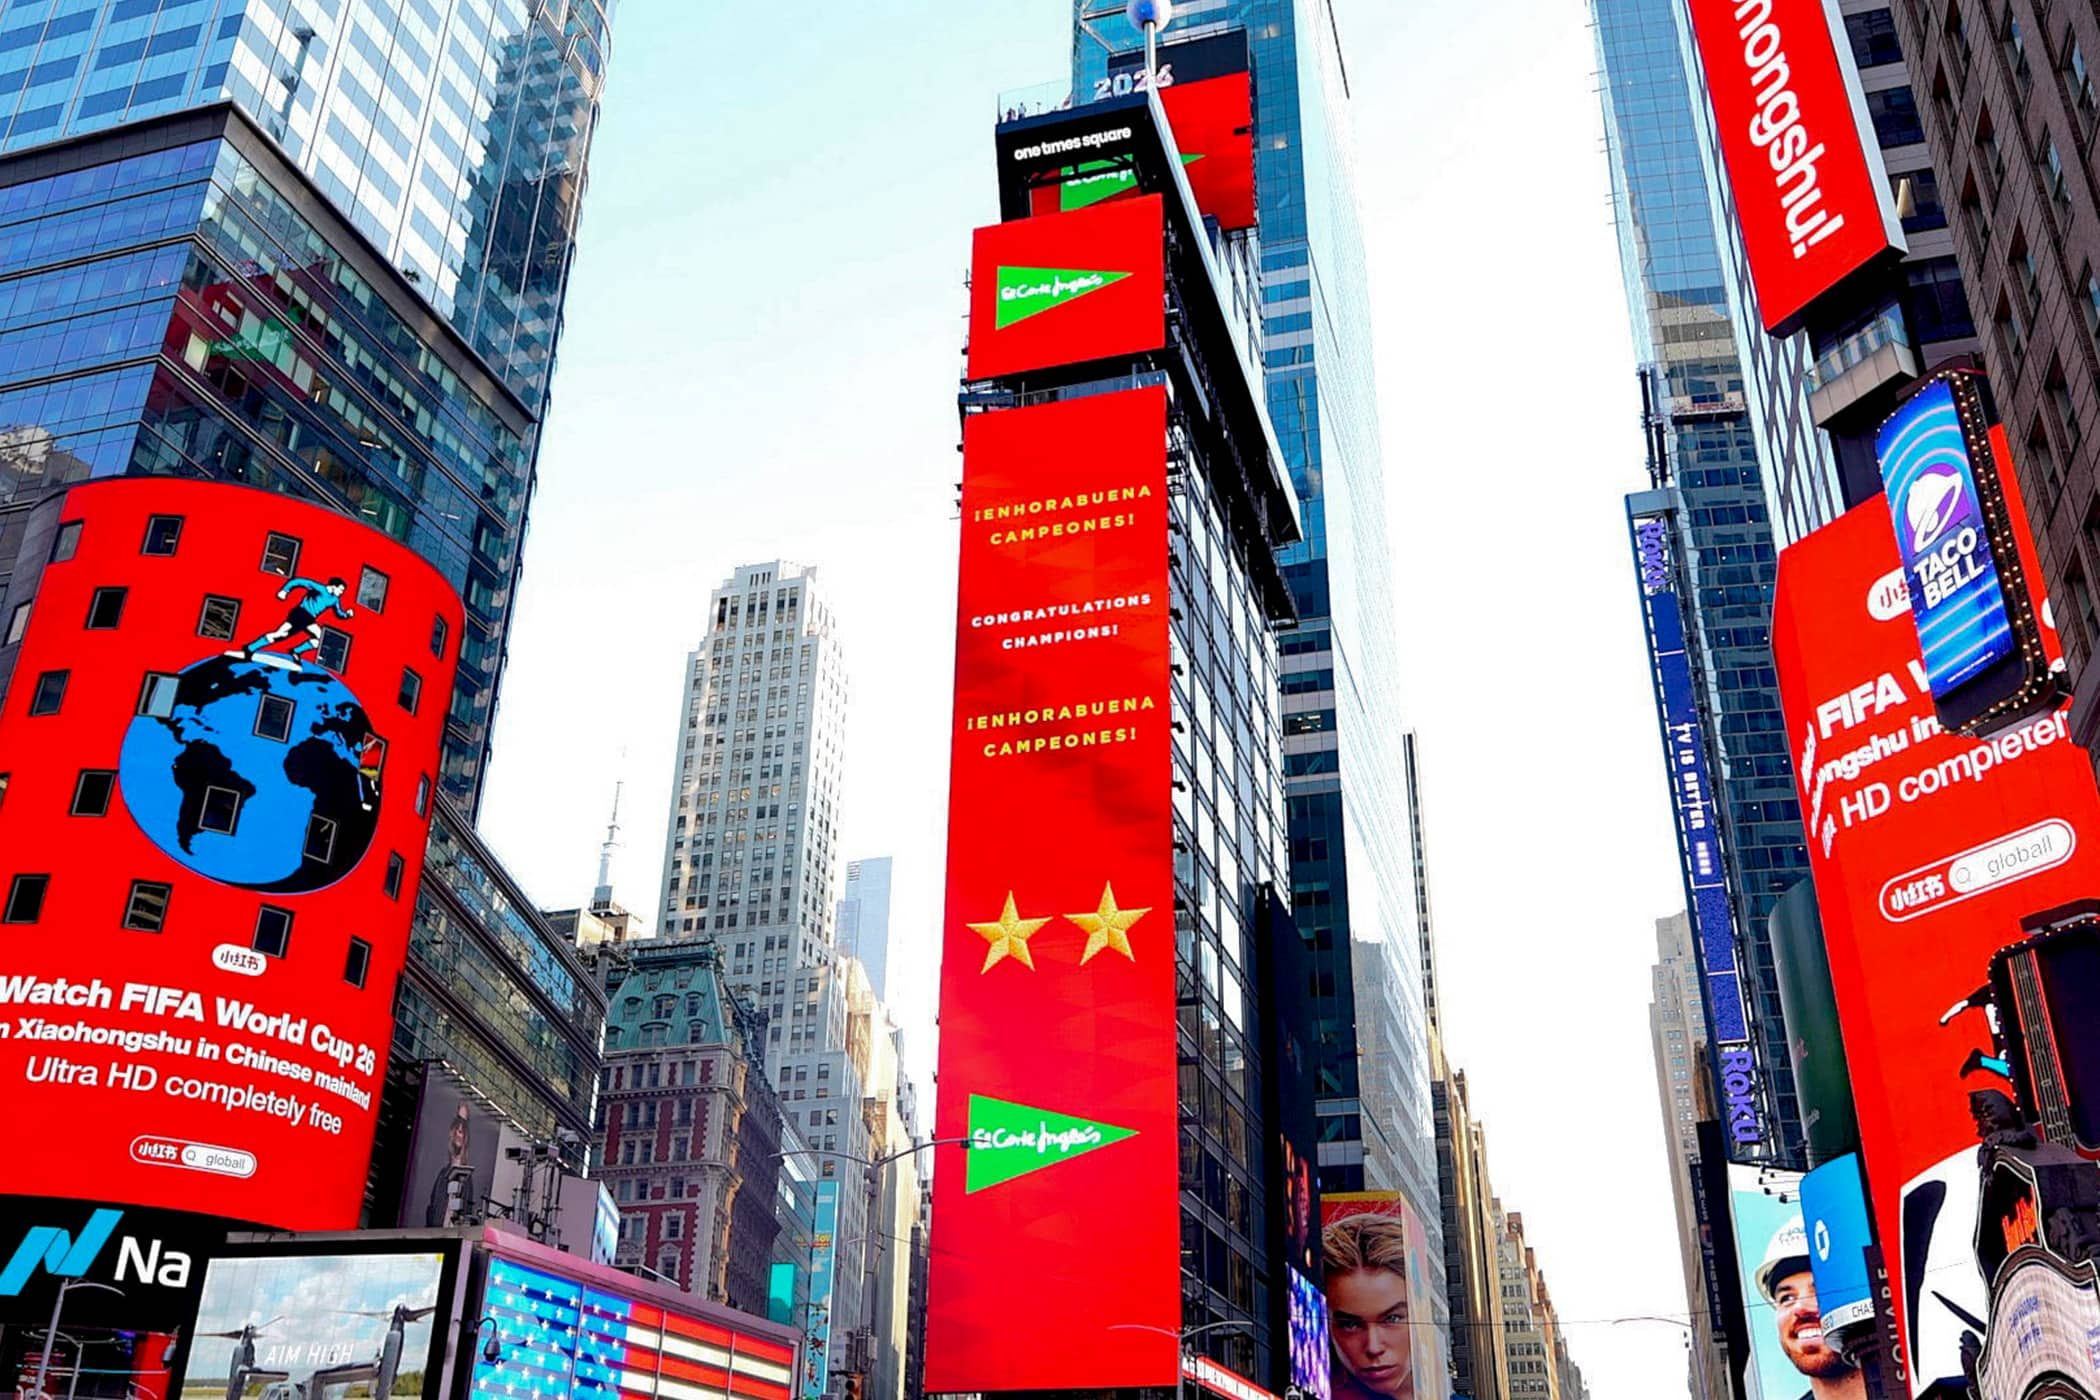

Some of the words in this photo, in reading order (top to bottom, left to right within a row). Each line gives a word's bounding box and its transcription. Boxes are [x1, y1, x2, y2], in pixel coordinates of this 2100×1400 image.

[1014, 146, 1042, 160] one
[1042, 137, 1082, 156] times
[1083, 126, 1132, 148] square
[974, 485, 1152, 522] ¡ENHORABUENA
[989, 513, 1135, 545] CAMPEONES!
[1913, 527, 1977, 586] TACO
[1922, 554, 1986, 610] BELL
[971, 593, 1152, 628] CONGRATULATIONS
[1002, 624, 1119, 650] CHAMPIONS!
[966, 696, 1155, 731] ¡ENHORABUENA
[1816, 672, 1908, 740] FIFA
[983, 727, 1137, 757] CAMPEONES!
[1679, 749, 1696, 766] IS
[1839, 782, 1890, 828] HD
[1899, 709, 2073, 803] completel
[1987, 835, 2053, 878] globall
[0, 975, 112, 1009] Watch
[119, 982, 206, 1022] FIFA
[215, 996, 306, 1045] World
[310, 1024, 353, 1069] Cup
[354, 1043, 376, 1077] 26
[13, 1017, 192, 1056] Xiaohongshu
[196, 1036, 221, 1060] in
[225, 1043, 312, 1083] Chinese
[313, 1070, 371, 1111] mainland
[25, 1056, 99, 1086] Ultra
[106, 1062, 157, 1092] HD
[164, 1075, 306, 1127] completely
[308, 1103, 343, 1135] free
[1720, 1051, 1759, 1142] ROKU
[205, 1152, 246, 1171] globall
[113, 1235, 192, 1289] Na
[263, 1346, 299, 1365] AIM
[306, 1343, 354, 1364] HIGH
